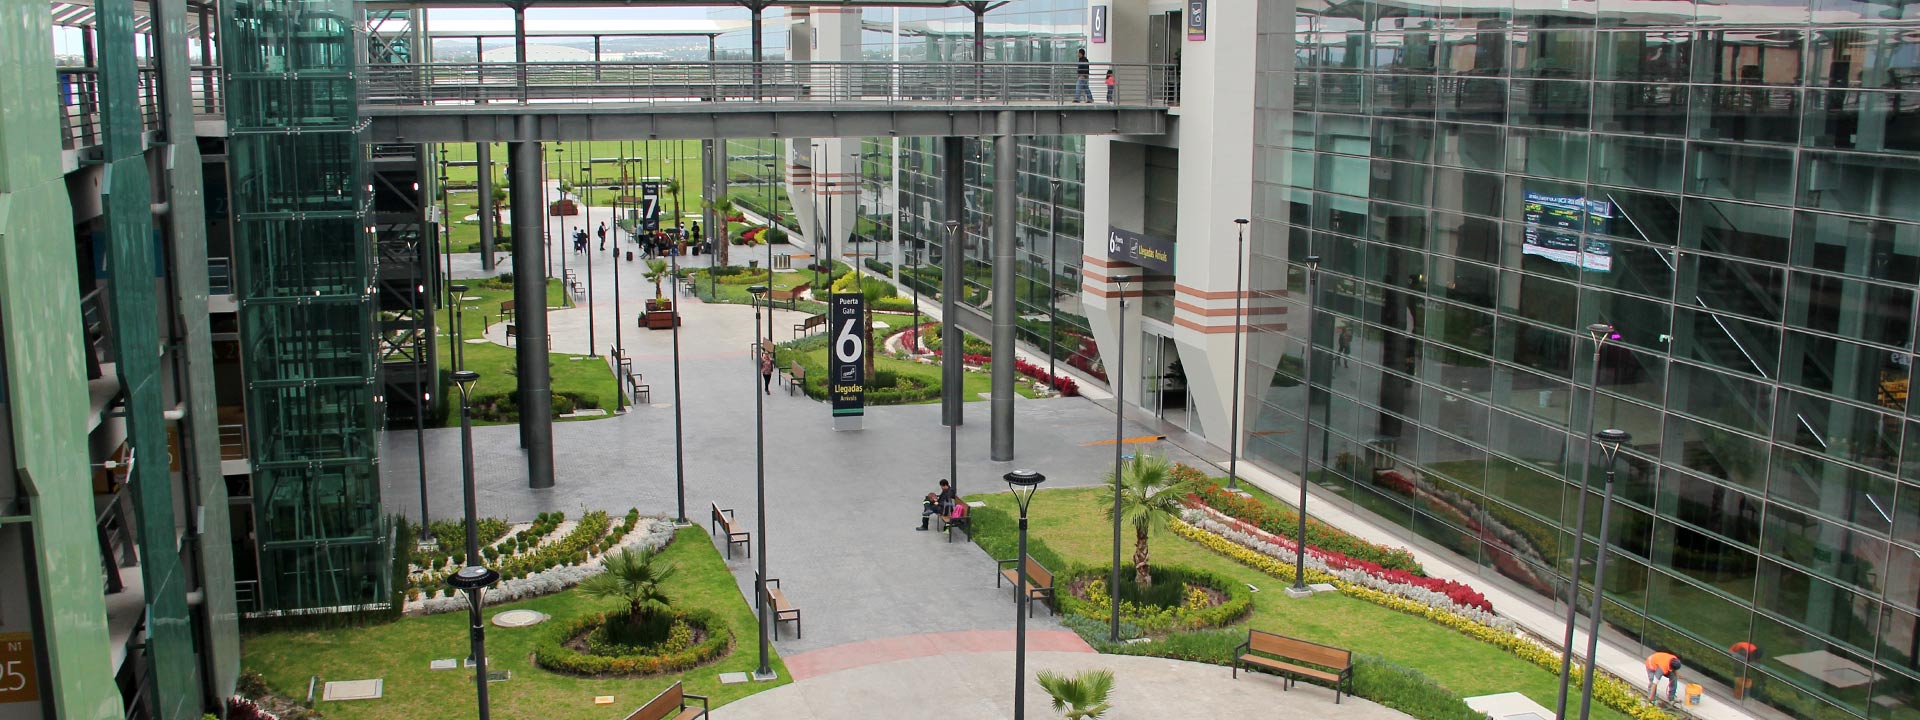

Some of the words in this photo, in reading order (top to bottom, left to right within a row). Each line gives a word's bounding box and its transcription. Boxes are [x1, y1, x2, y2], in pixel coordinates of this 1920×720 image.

[1095, 8, 1101, 31] 6
[643, 195, 658, 219] 7
[1110, 231, 1115, 253] 6
[1138, 244, 1154, 259] Llegadas
[839, 297, 859, 305] Puerta
[842, 307, 855, 315] Gate
[836, 318, 862, 363] 6
[834, 384, 863, 394] Llegadas
[8, 641, 22, 652] N1
